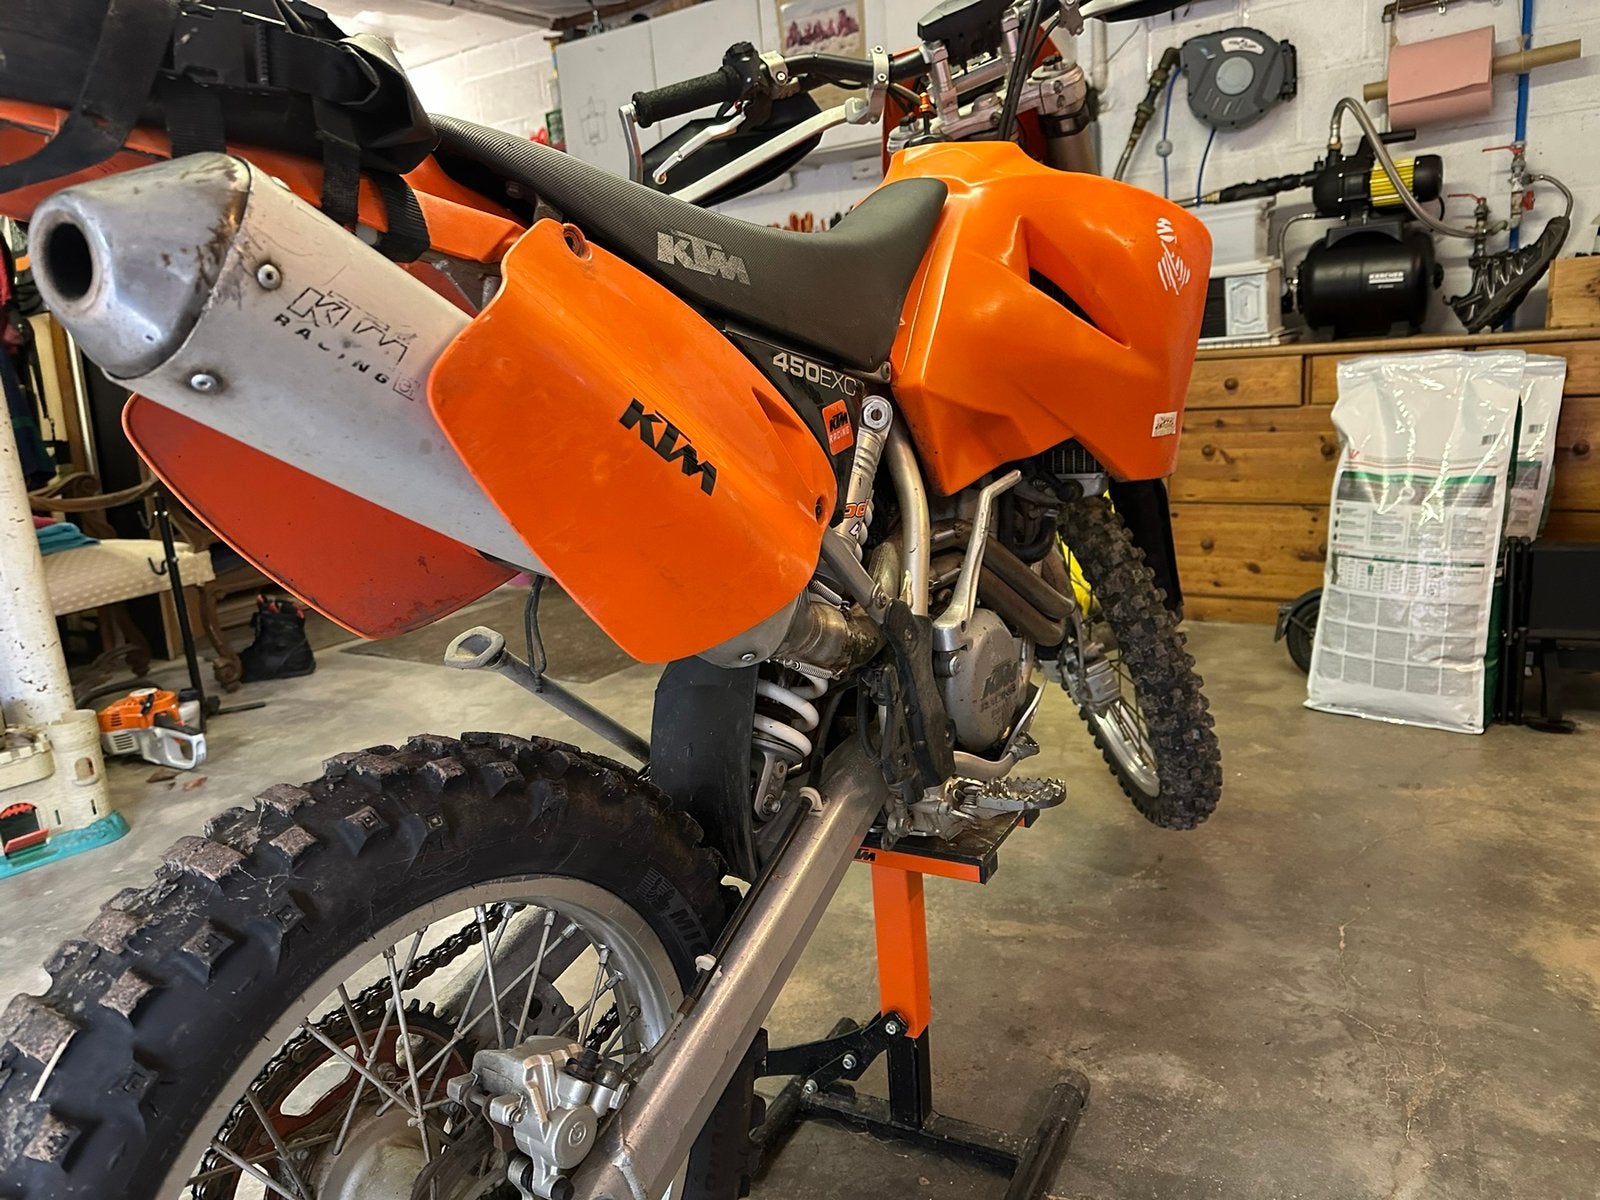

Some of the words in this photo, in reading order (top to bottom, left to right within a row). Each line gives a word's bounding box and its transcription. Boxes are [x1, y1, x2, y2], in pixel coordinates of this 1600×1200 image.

[657, 229, 751, 286] KTM
[274, 313, 390, 384] RANG
[772, 352, 857, 397] 450EXC
[618, 397, 717, 497] KTM
[829, 411, 849, 433] KTM
